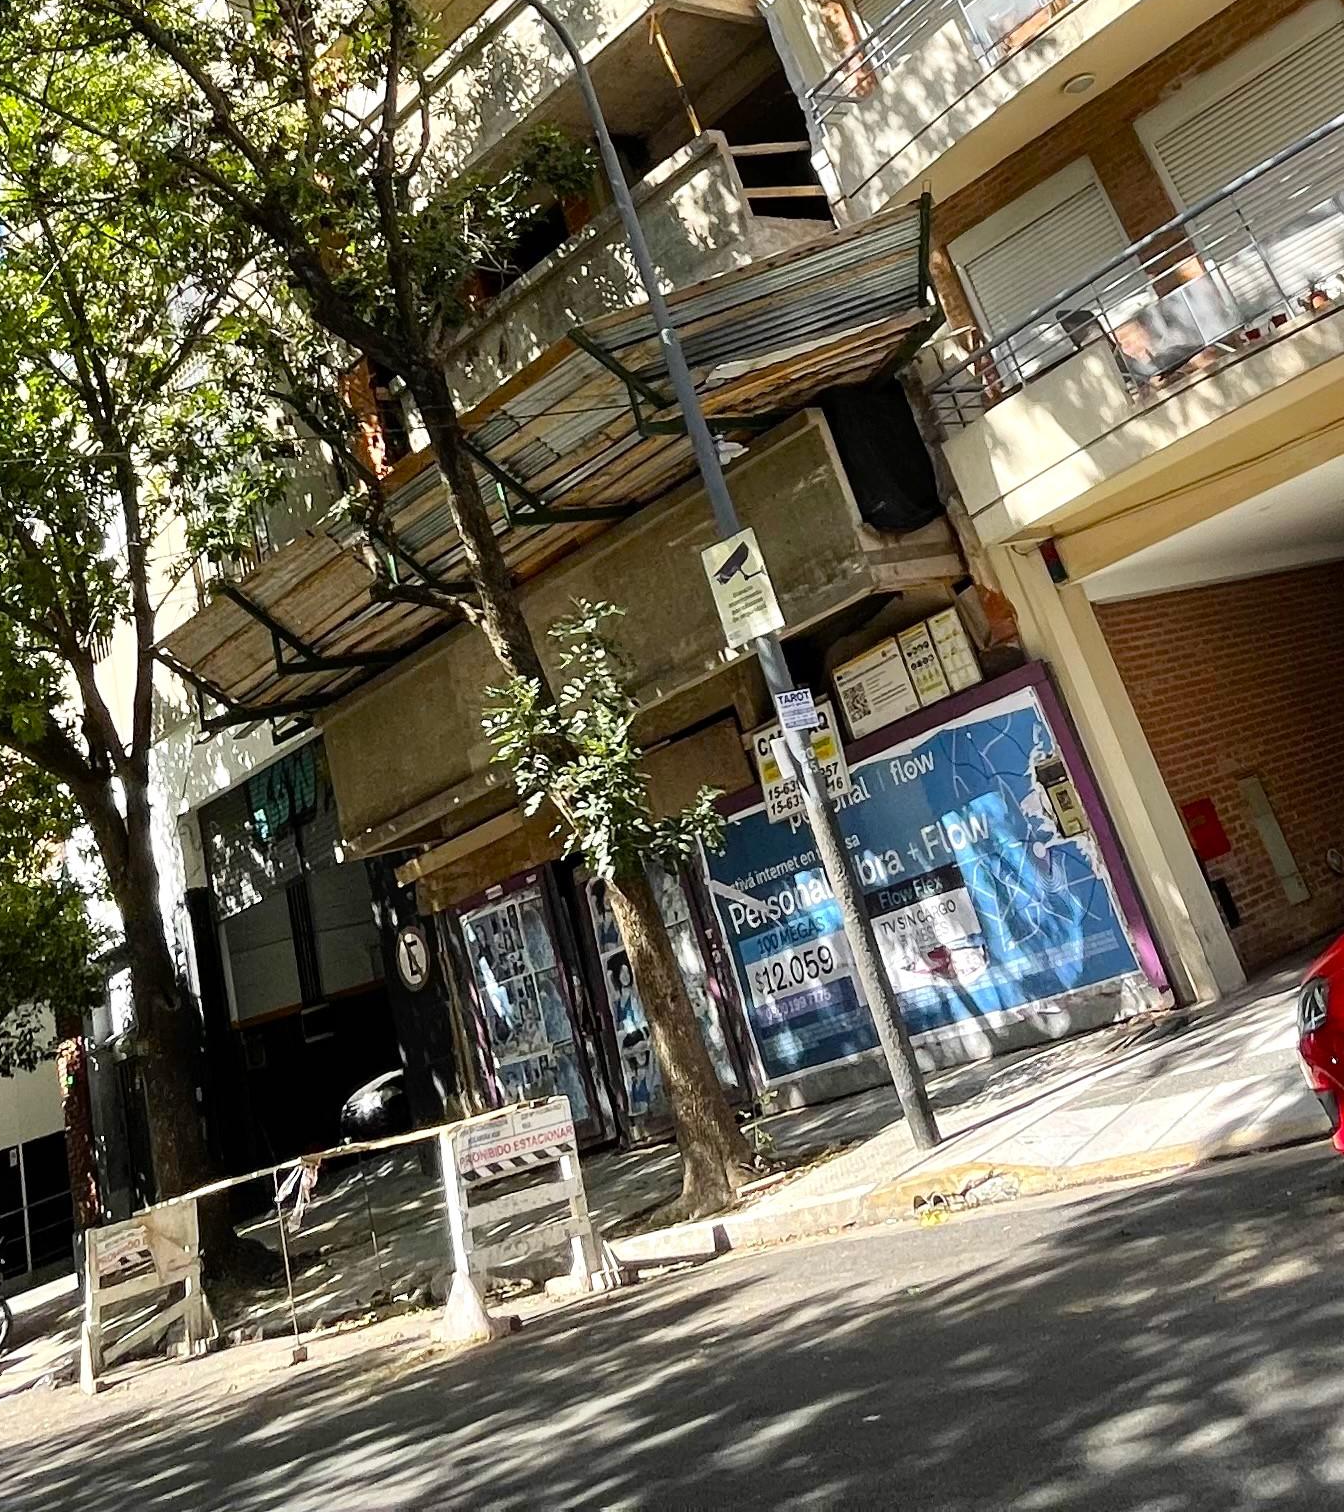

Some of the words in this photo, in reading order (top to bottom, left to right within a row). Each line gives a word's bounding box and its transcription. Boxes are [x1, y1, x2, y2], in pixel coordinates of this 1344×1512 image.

[777, 690, 810, 706] TAROT
[889, 750, 935, 786] flow
[920, 812, 990, 861] Flow
[755, 854, 799, 885] internet
[800, 852, 816, 866] en
[878, 887, 913, 910] Flow
[913, 876, 944, 898] Flex
[880, 919, 896, 935] TV
[916, 899, 957, 924] CARGO
[757, 933, 778, 955] 100
[778, 916, 825, 948] MEGAS
[754, 945, 833, 995] $12.059
[459, 1142, 512, 1171] PROHIBIDO
[513, 1124, 575, 1152] ESTACIONAR
